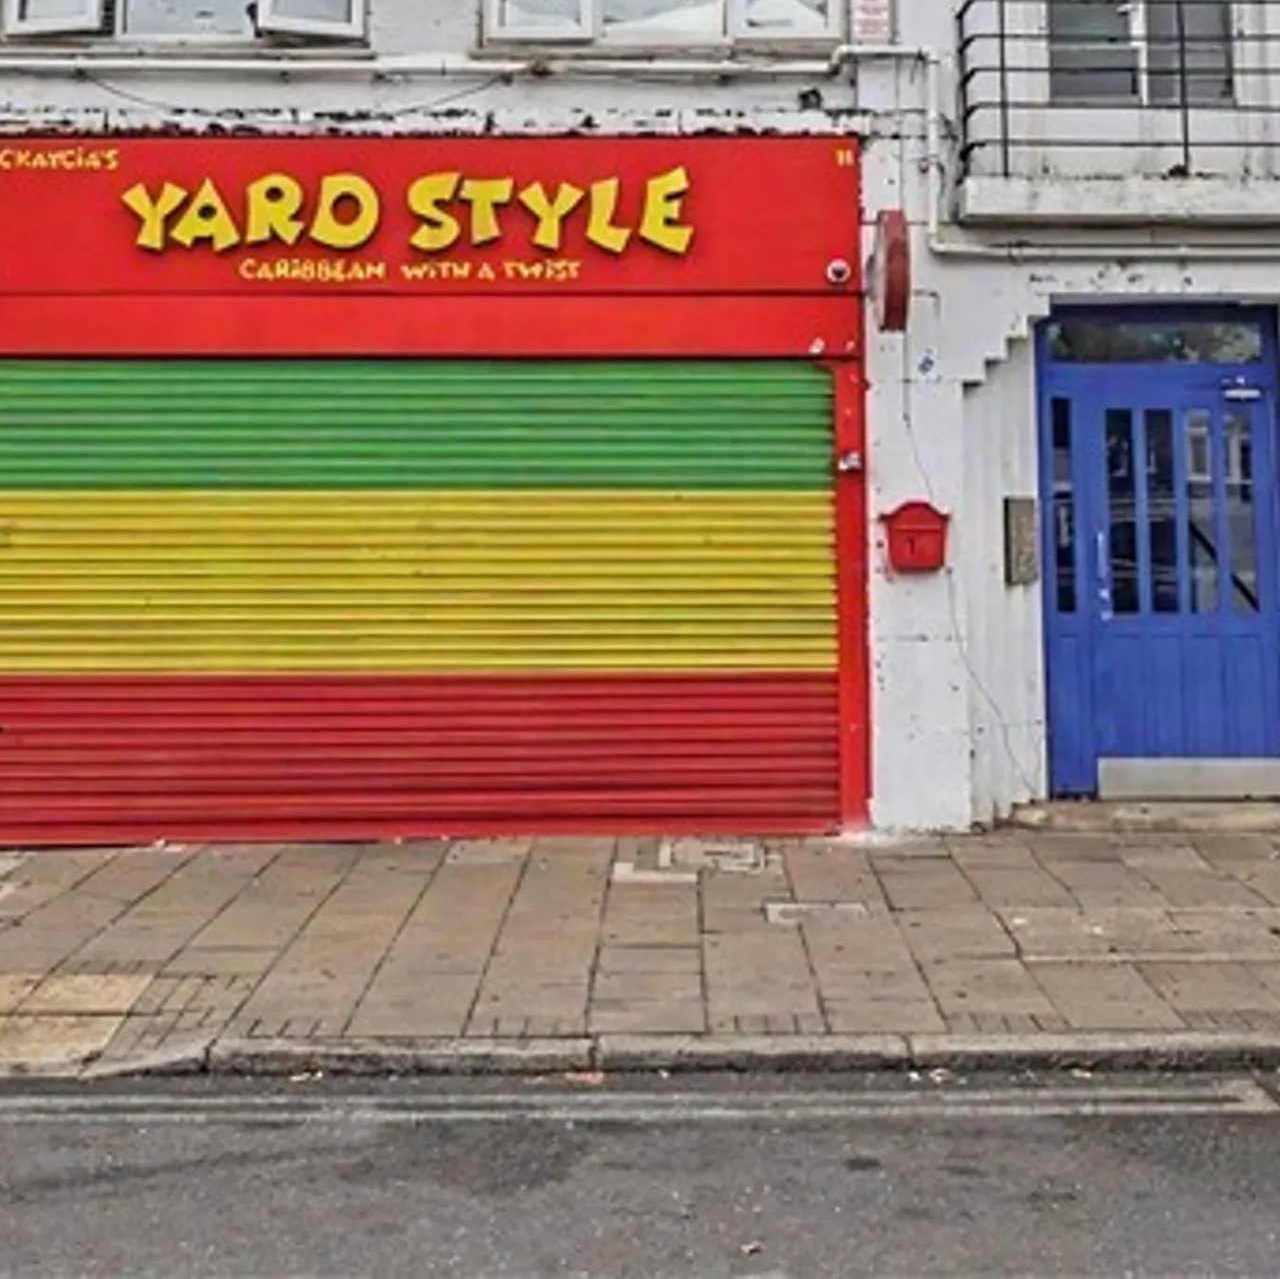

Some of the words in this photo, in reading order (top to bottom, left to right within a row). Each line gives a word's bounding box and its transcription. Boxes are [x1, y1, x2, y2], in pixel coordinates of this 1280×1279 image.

[121, 173, 381, 252] YARD
[407, 166, 695, 254] STYLE
[477, 262, 496, 281] A
